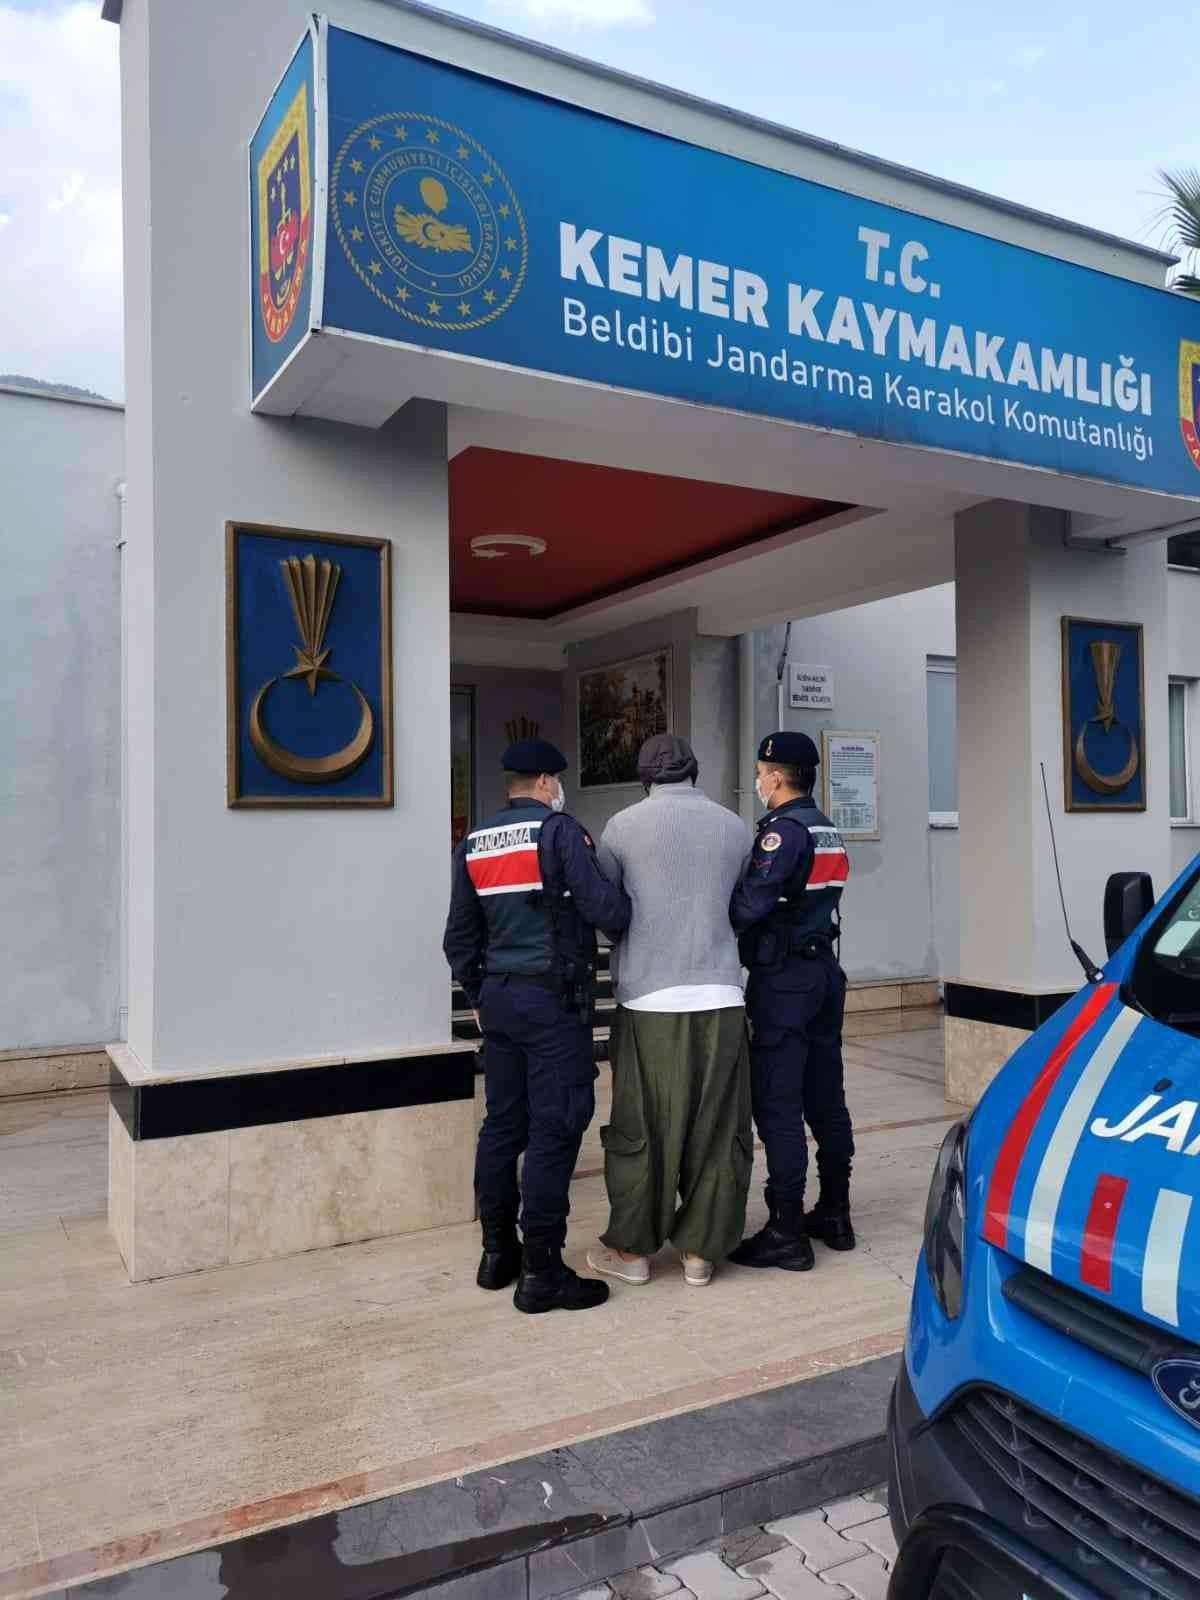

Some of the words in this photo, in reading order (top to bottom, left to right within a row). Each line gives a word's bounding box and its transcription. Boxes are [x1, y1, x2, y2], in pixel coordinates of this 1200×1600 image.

[858, 226, 940, 298] T.C.
[559, 221, 769, 328] KEMER
[787, 283, 1152, 416] KAYMAKAMLIĞI
[562, 297, 692, 361] Beldibi
[707, 334, 873, 400] Jandarma
[885, 372, 995, 424] Karakol
[1004, 398, 1153, 461] Komutanlığı
[471, 827, 532, 854] JANDARMA
[1090, 1094, 1200, 1156] JA
